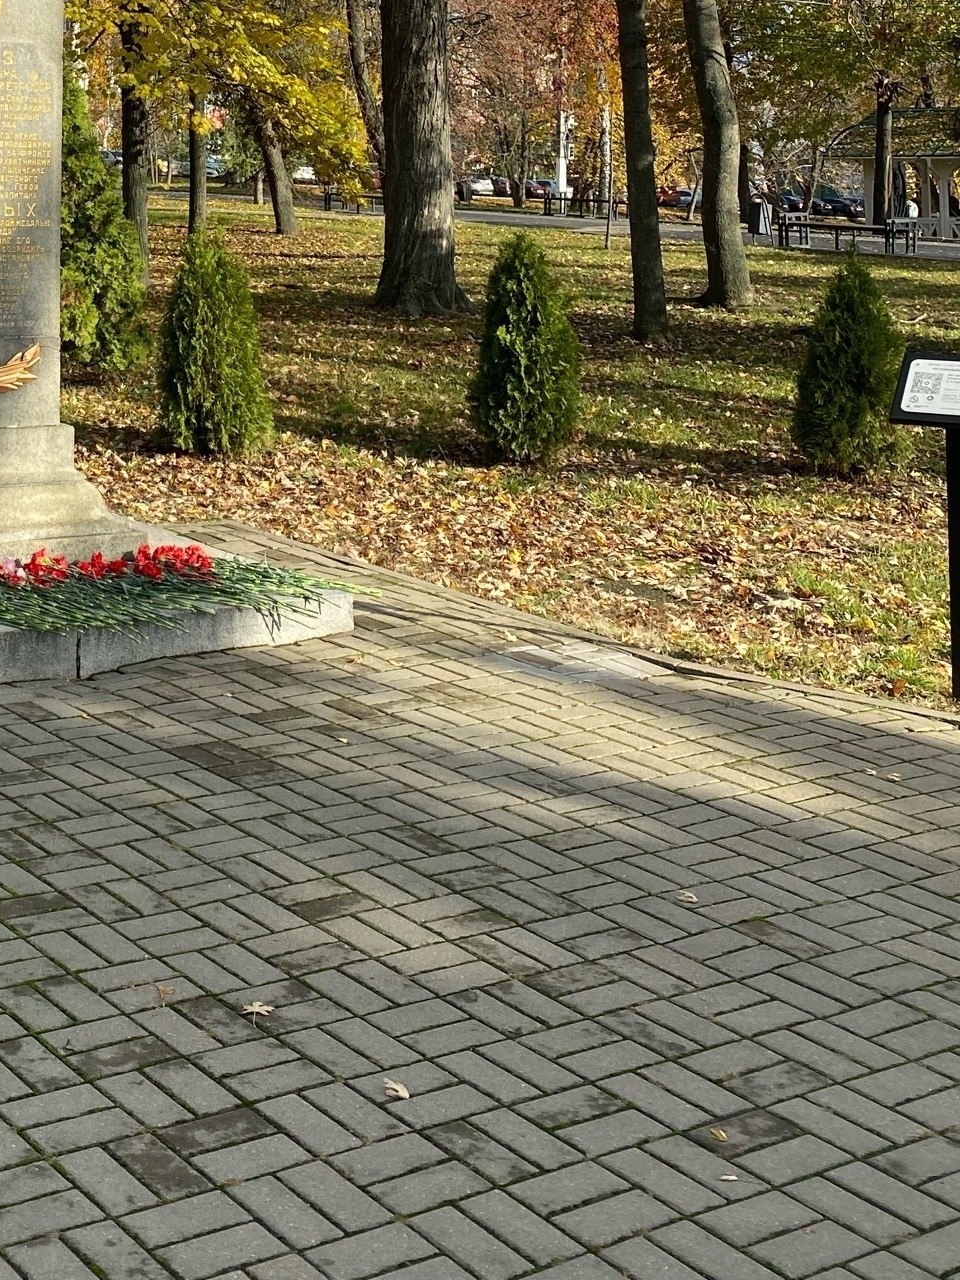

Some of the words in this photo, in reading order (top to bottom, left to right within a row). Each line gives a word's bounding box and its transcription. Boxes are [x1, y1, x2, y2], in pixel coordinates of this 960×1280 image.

[2, 166, 45, 174] ПОЛУЧЕНИЕ
[14, 182, 39, 191] ГЕРОЯ
[16, 219, 51, 227] МЕДАЛЬЮ
[16, 236, 31, 244] ЕГО
